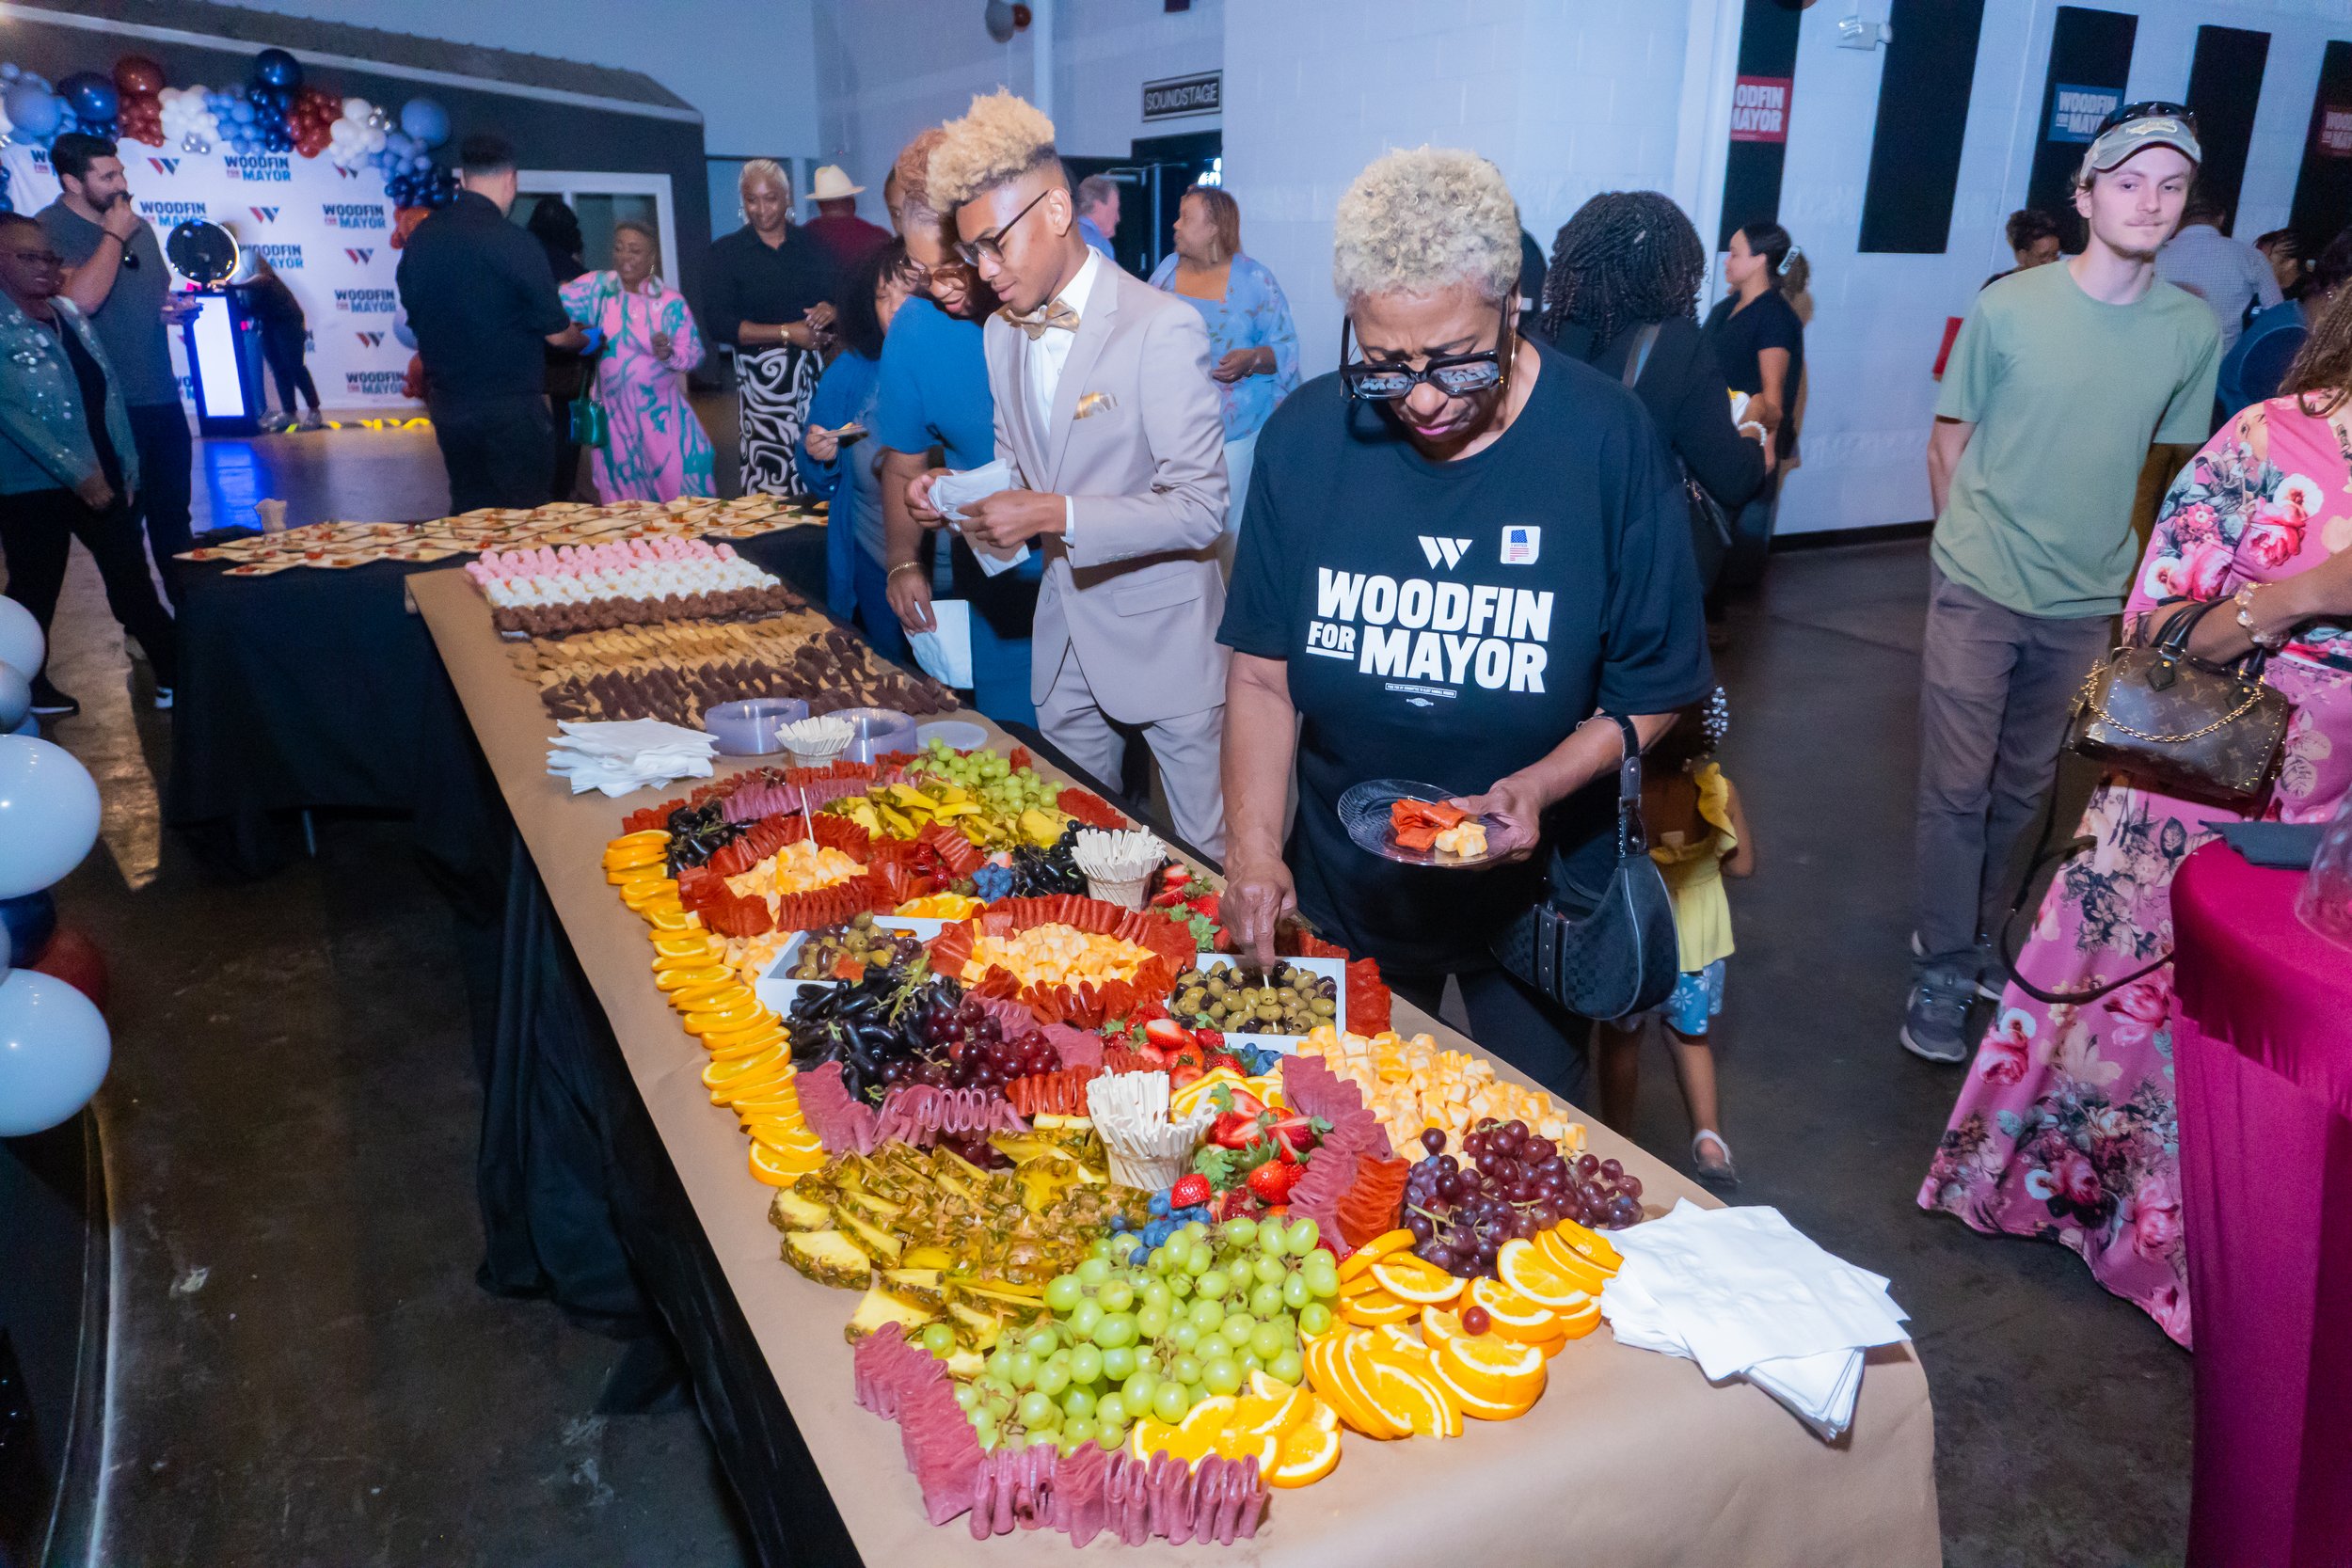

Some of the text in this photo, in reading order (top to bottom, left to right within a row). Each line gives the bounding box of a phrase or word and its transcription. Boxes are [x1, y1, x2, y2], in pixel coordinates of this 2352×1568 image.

[1145, 83, 1218, 111] SOUNDSTAGE
[1736, 85, 1786, 108] ODFIN
[2058, 91, 2118, 115] WOODFIN
[224, 155, 290, 168] WOODFIN
[242, 170, 291, 182] MAYOR
[140, 201, 206, 214] WOODFIN
[323, 204, 384, 216] WOODFIN
[339, 217, 386, 229] MAYOR
[268, 258, 304, 269] AYOR
[334, 289, 395, 301] WOODFIN
[350, 301, 397, 313] MAYOR
[361, 382, 405, 394] MAYO
[1317, 566, 1554, 642] WOODFIN
[1307, 620, 1548, 693] FOR MAYOR
